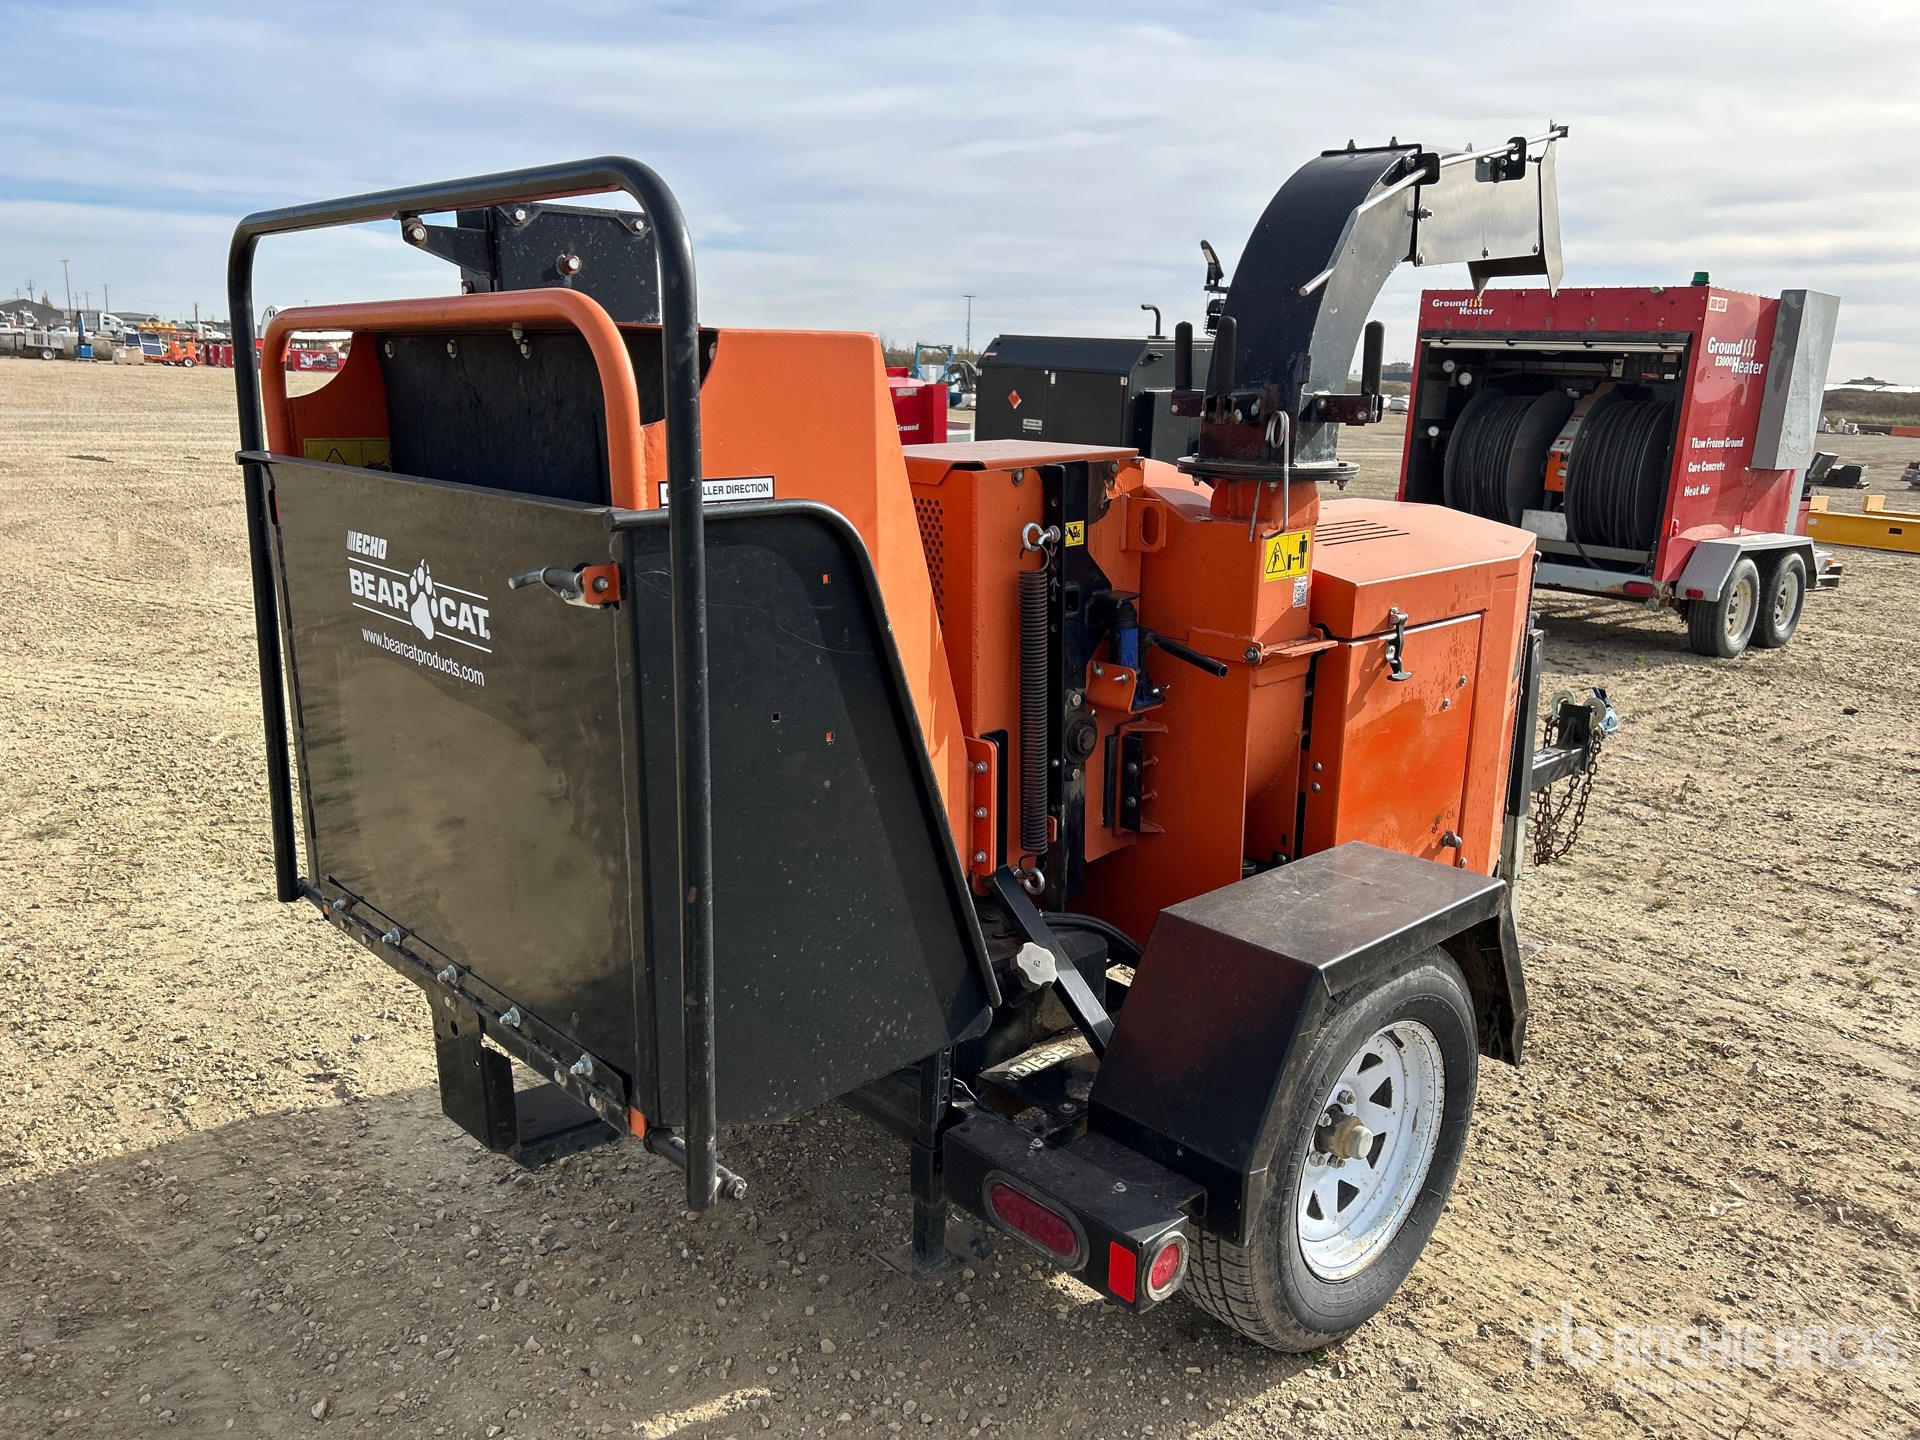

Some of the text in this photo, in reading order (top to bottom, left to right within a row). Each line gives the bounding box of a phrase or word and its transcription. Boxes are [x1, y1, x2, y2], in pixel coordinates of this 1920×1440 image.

[1432, 298, 1468, 307] Ground
[1459, 307, 1494, 315] Heater
[1707, 336, 1743, 355] Ground
[1731, 357, 1764, 375] Heater
[1691, 437, 1745, 448] Thaw Frozen Ground
[1688, 460, 1726, 473] Cure Concrete
[702, 483, 769, 496] LLER DIRECTION
[1684, 484, 1711, 497] Heat Air
[353, 531, 388, 561] ECHO
[348, 567, 409, 613] BEAR
[361, 627, 485, 687] www.bearcatproducts.com
